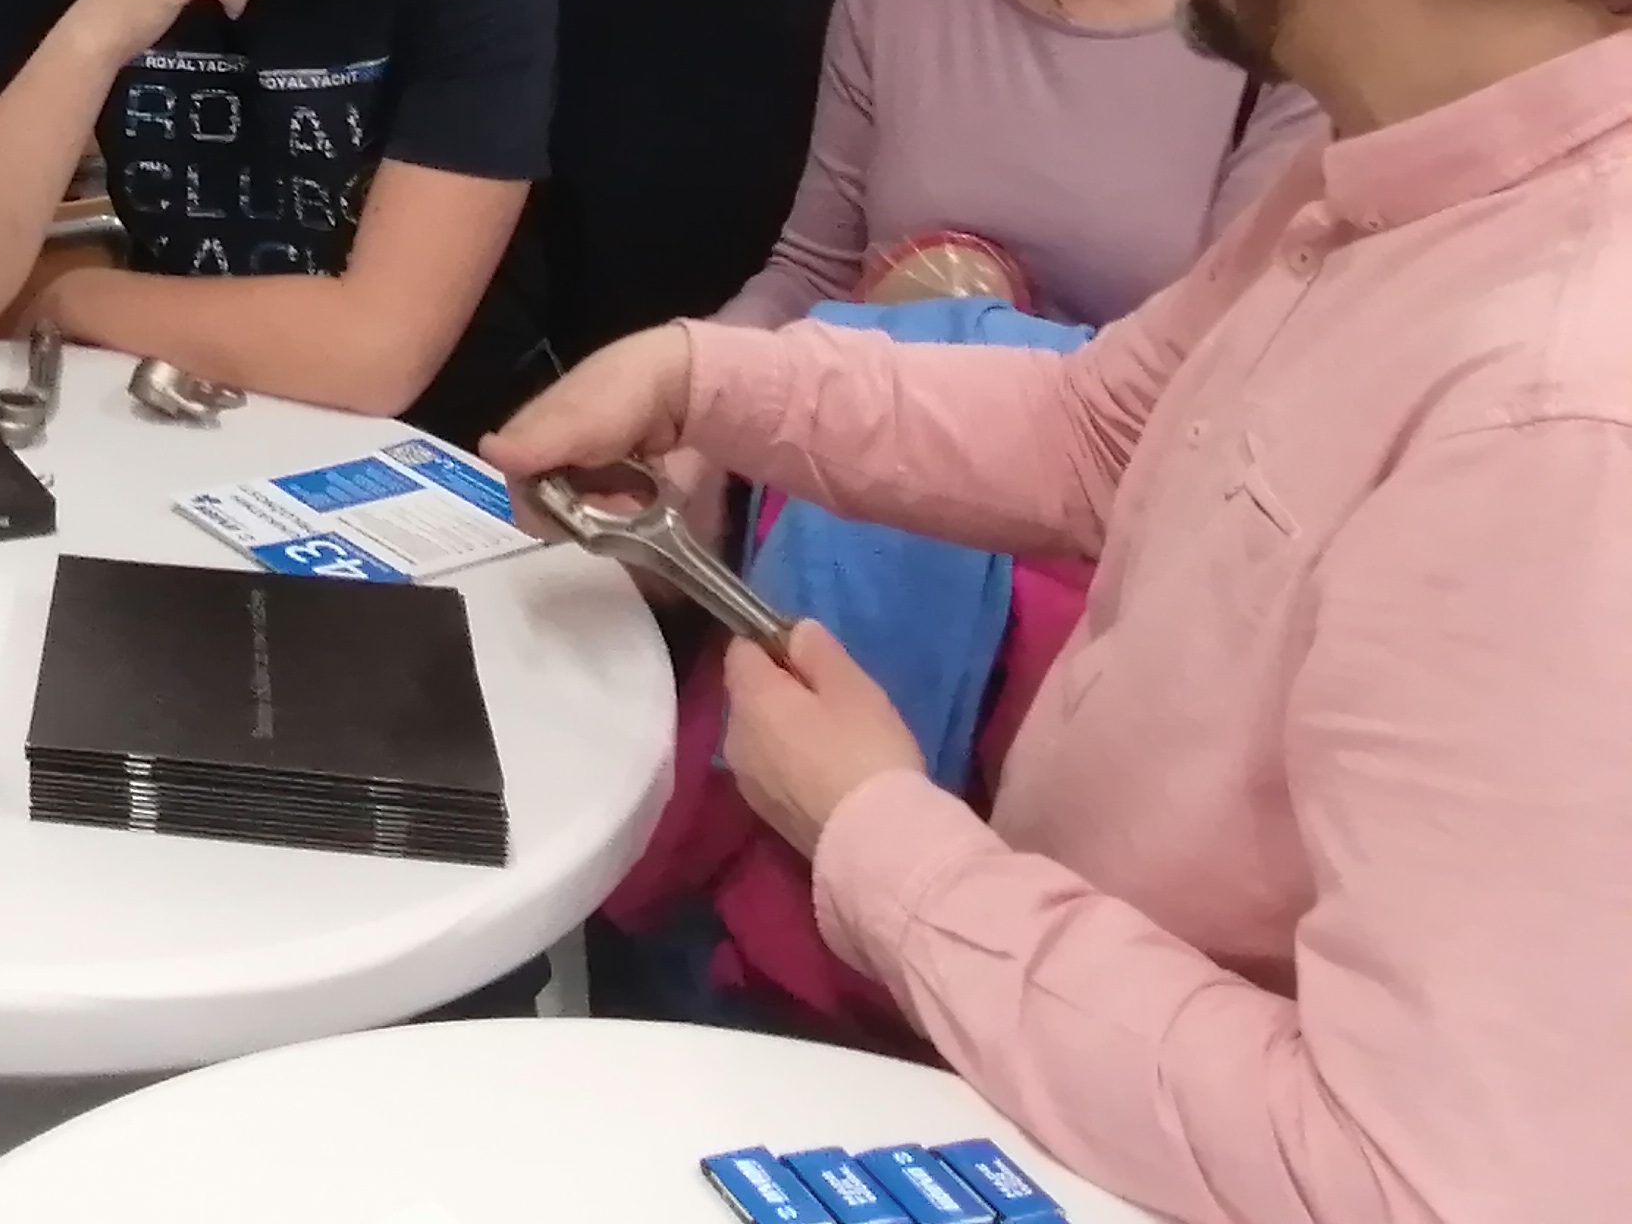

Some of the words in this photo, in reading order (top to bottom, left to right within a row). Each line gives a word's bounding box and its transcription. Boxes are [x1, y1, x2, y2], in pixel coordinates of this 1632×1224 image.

[145, 56, 195, 71] ROYAL
[310, 70, 358, 89] YACHT
[284, 539, 369, 582] 43
